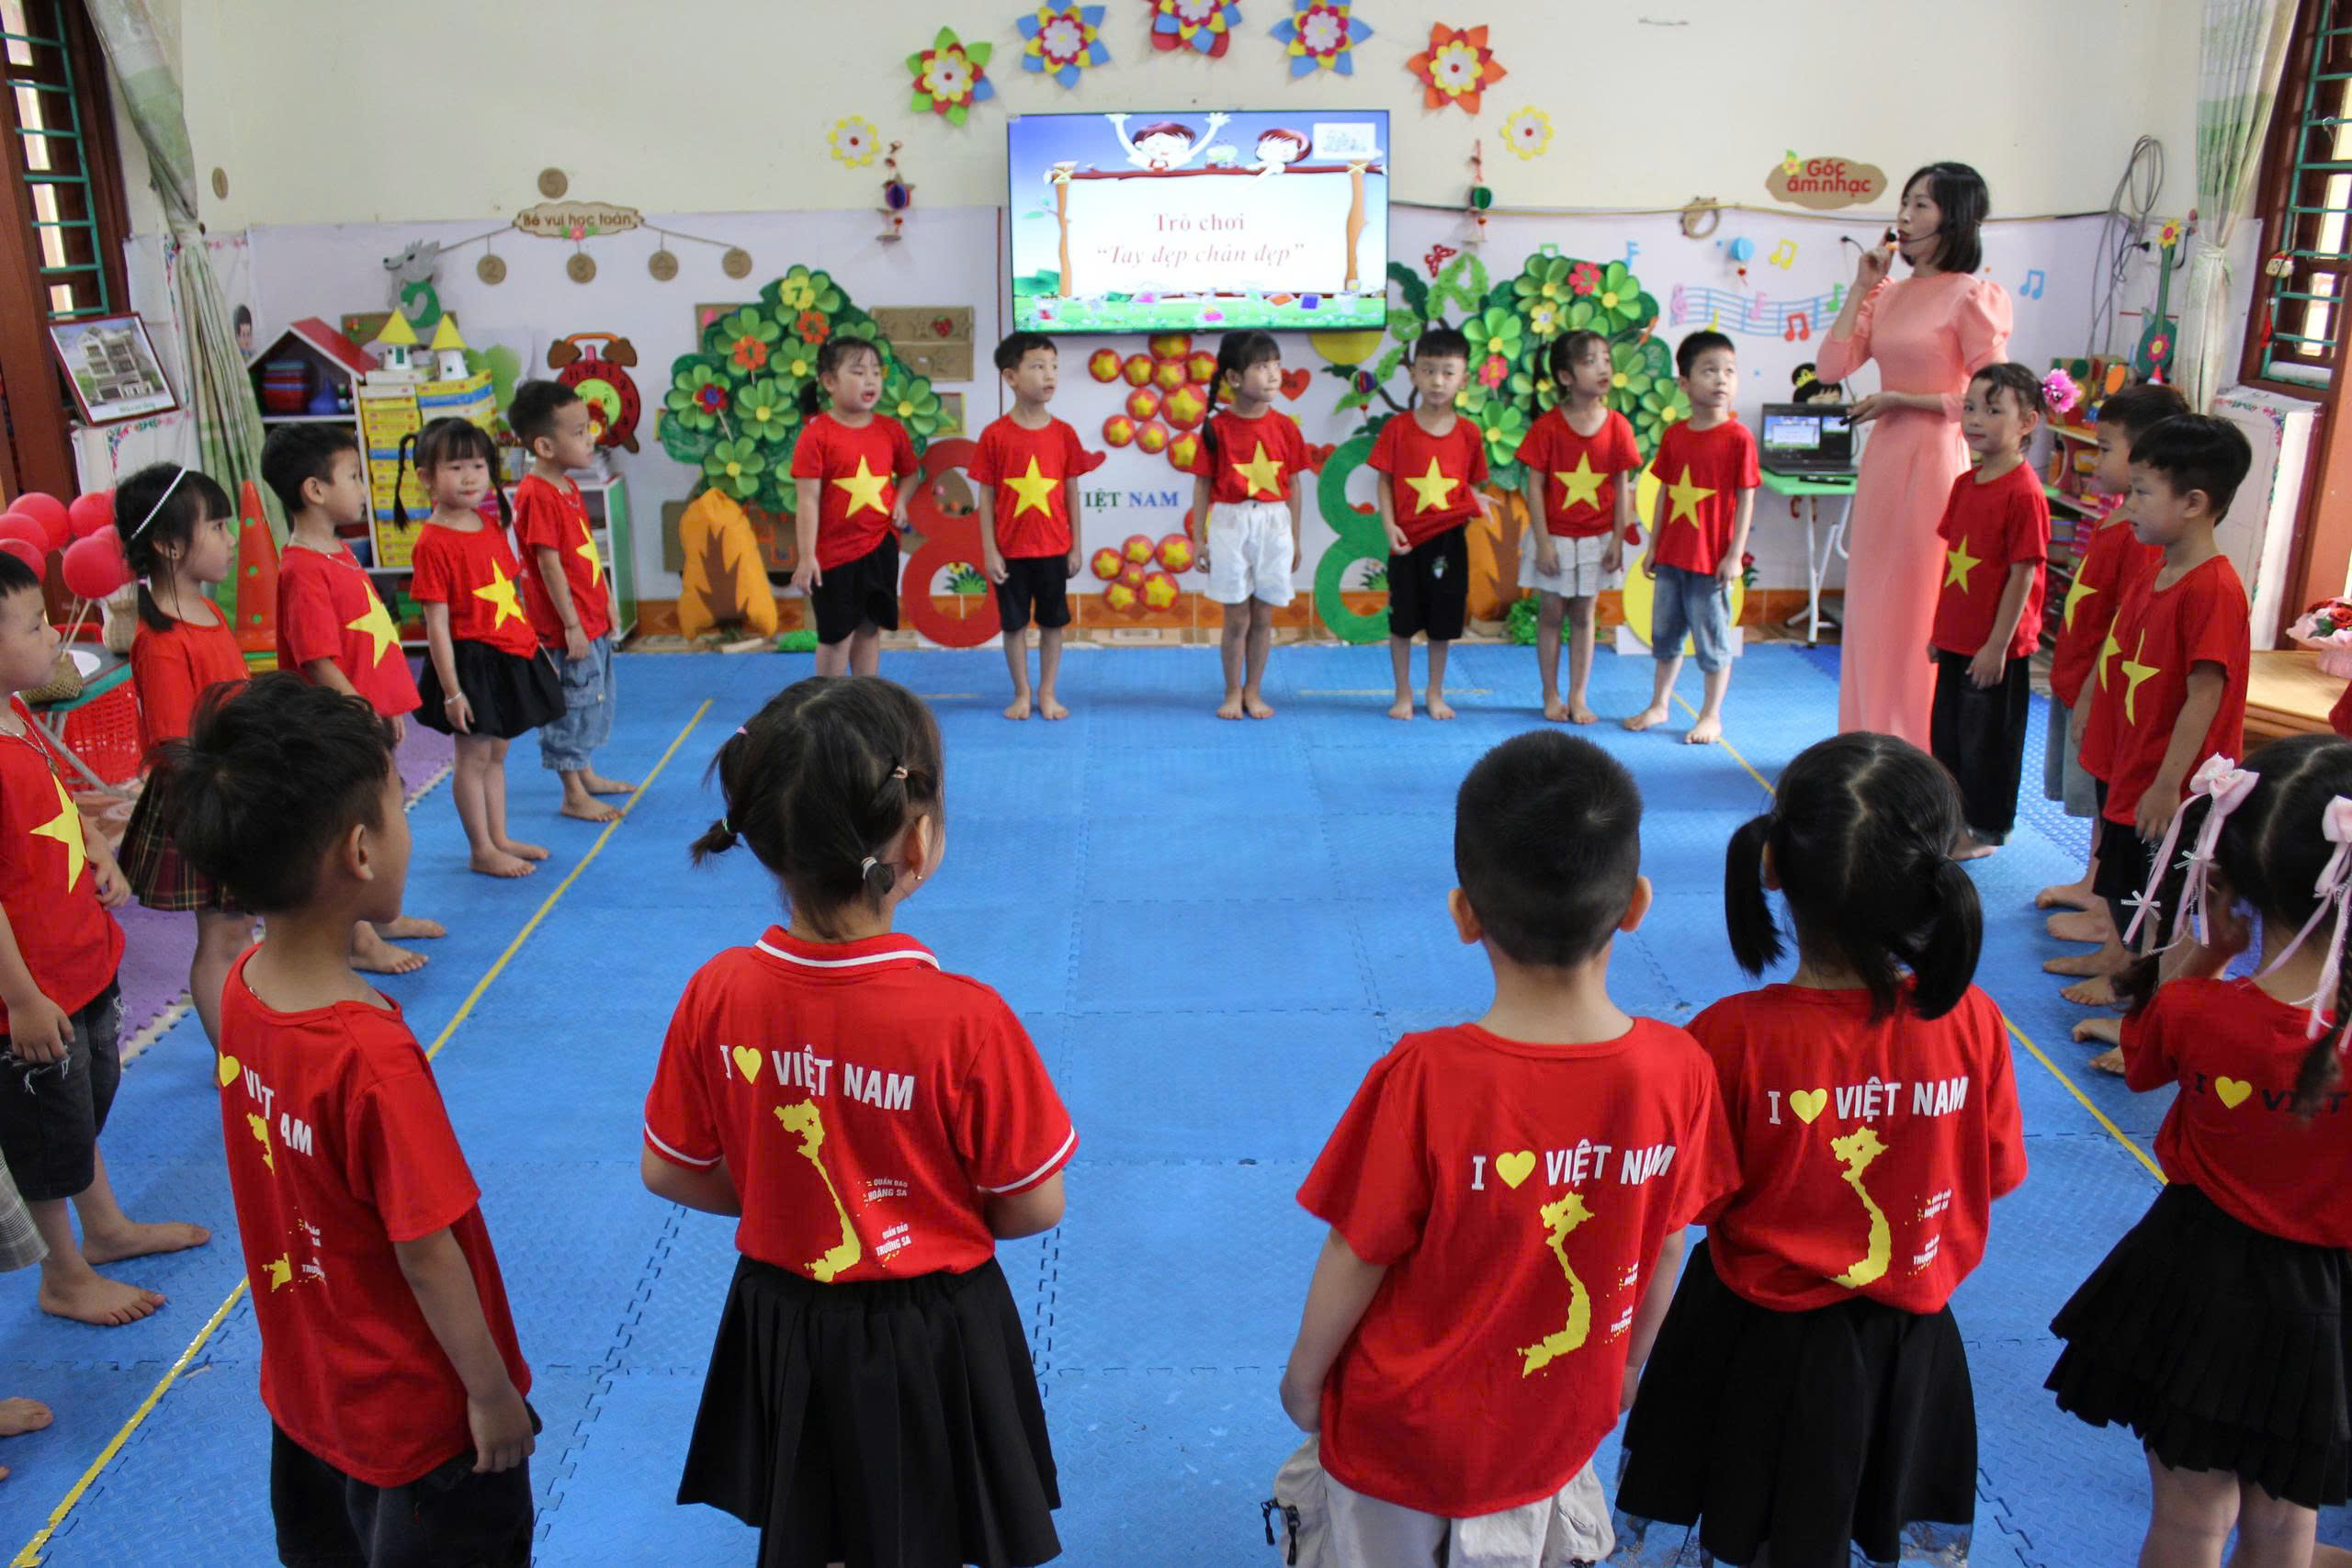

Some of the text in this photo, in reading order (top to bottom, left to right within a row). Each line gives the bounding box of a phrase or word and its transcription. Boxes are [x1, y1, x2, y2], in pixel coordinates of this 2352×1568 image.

[1807, 159, 1847, 177] Góc
[1787, 175, 1871, 197] âm nhạc
[523, 213, 632, 228] Bé vui học toán
[1154, 212, 1245, 231] Trò chơi
[1152, 244, 1189, 268] đẹp
[1195, 243, 1247, 263] chân
[1081, 489, 1178, 513] IỆT NAM
[772, 1043, 833, 1096] VIỆT
[843, 1063, 915, 1111] NAM
[1768, 1076, 1969, 1125] I VIỆT NAM
[1471, 1138, 1677, 1190] I VIỆT NAM
[896, 1188, 908, 1197] SA
[901, 1235, 912, 1247] SA
